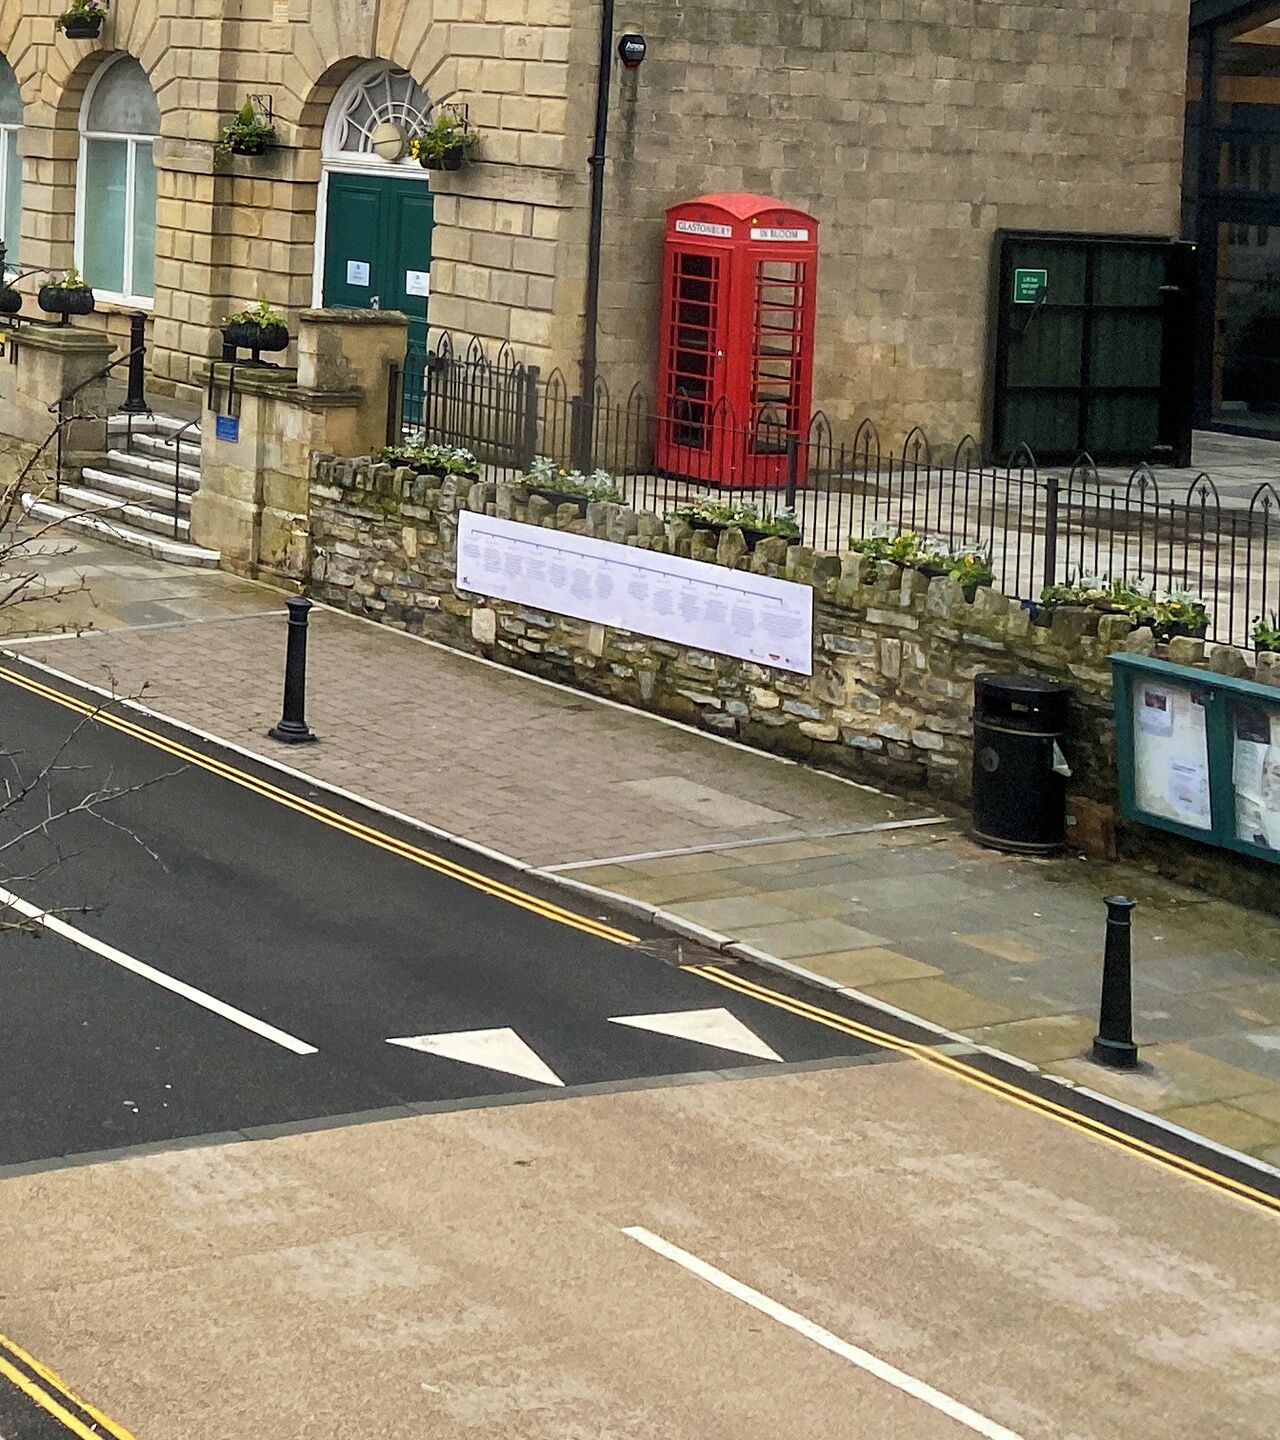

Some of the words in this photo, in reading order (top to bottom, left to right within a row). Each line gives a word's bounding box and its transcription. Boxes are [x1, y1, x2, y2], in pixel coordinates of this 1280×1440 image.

[678, 221, 730, 236] GLASTONBURY
[760, 229, 768, 237] IN
[770, 229, 798, 239] BLOOM
